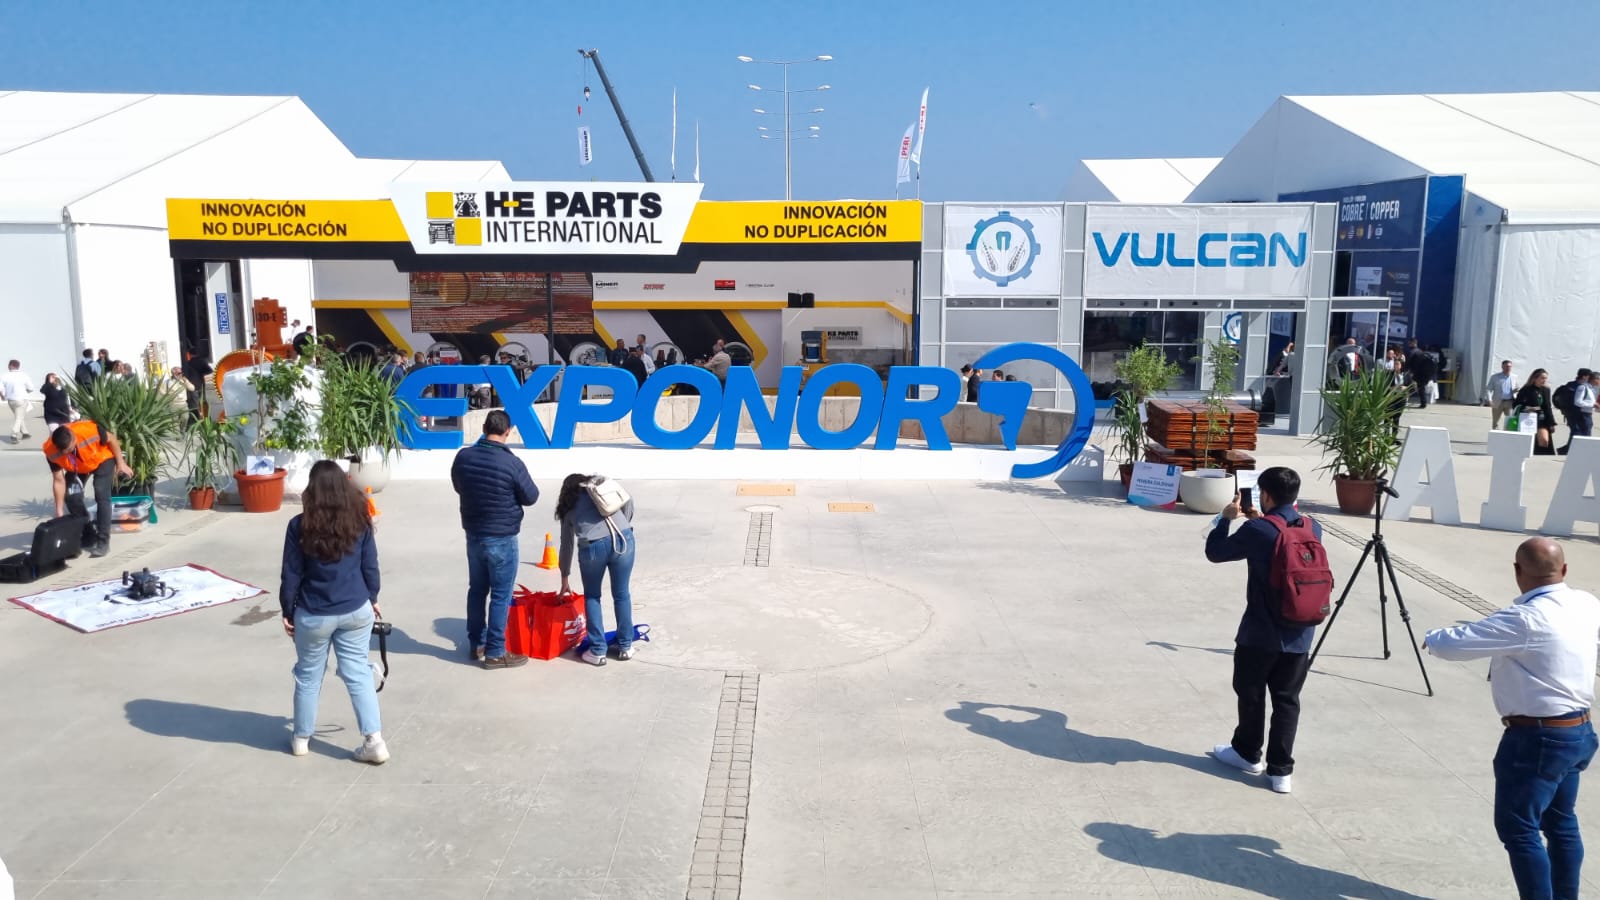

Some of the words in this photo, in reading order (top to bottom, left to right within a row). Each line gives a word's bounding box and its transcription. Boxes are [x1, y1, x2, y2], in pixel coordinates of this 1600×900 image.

[201, 200, 306, 217] INNOVACIÓN
[546, 191, 663, 219] PARTS
[784, 202, 887, 219] INNOVACIÓN
[1341, 202, 1365, 221] COBRE
[1370, 200, 1400, 220] COPPER
[202, 222, 228, 235] NO
[233, 220, 348, 237] DUPLICACIÓN
[486, 220, 663, 243] INTERNATIONAL
[745, 225, 769, 238] NO
[774, 221, 887, 238] DUPLICACIÓN
[397, 363, 962, 451] EXPONOR
